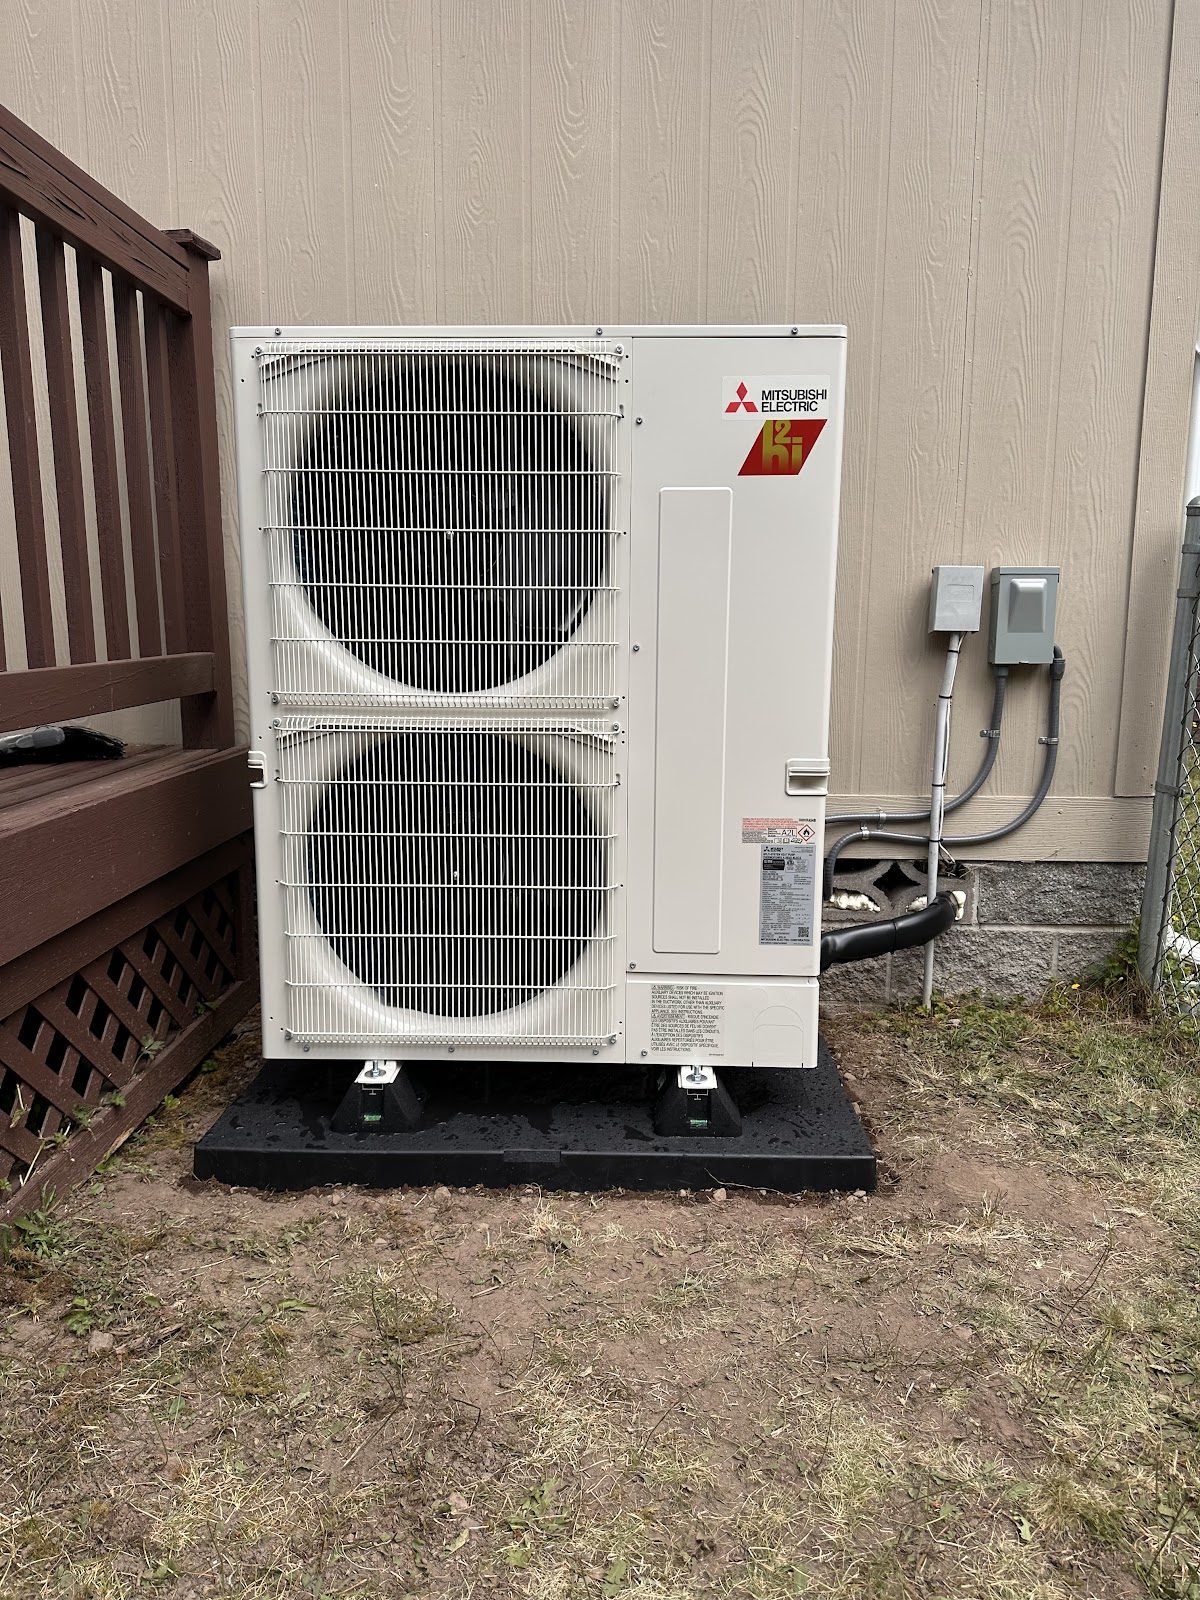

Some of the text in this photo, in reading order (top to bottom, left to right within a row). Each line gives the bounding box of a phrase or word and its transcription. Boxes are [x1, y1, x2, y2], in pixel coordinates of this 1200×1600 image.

[761, 389, 827, 401] MITSUBISHI
[761, 401, 818, 412] ELECTRIC
[781, 829, 796, 837] A2L
